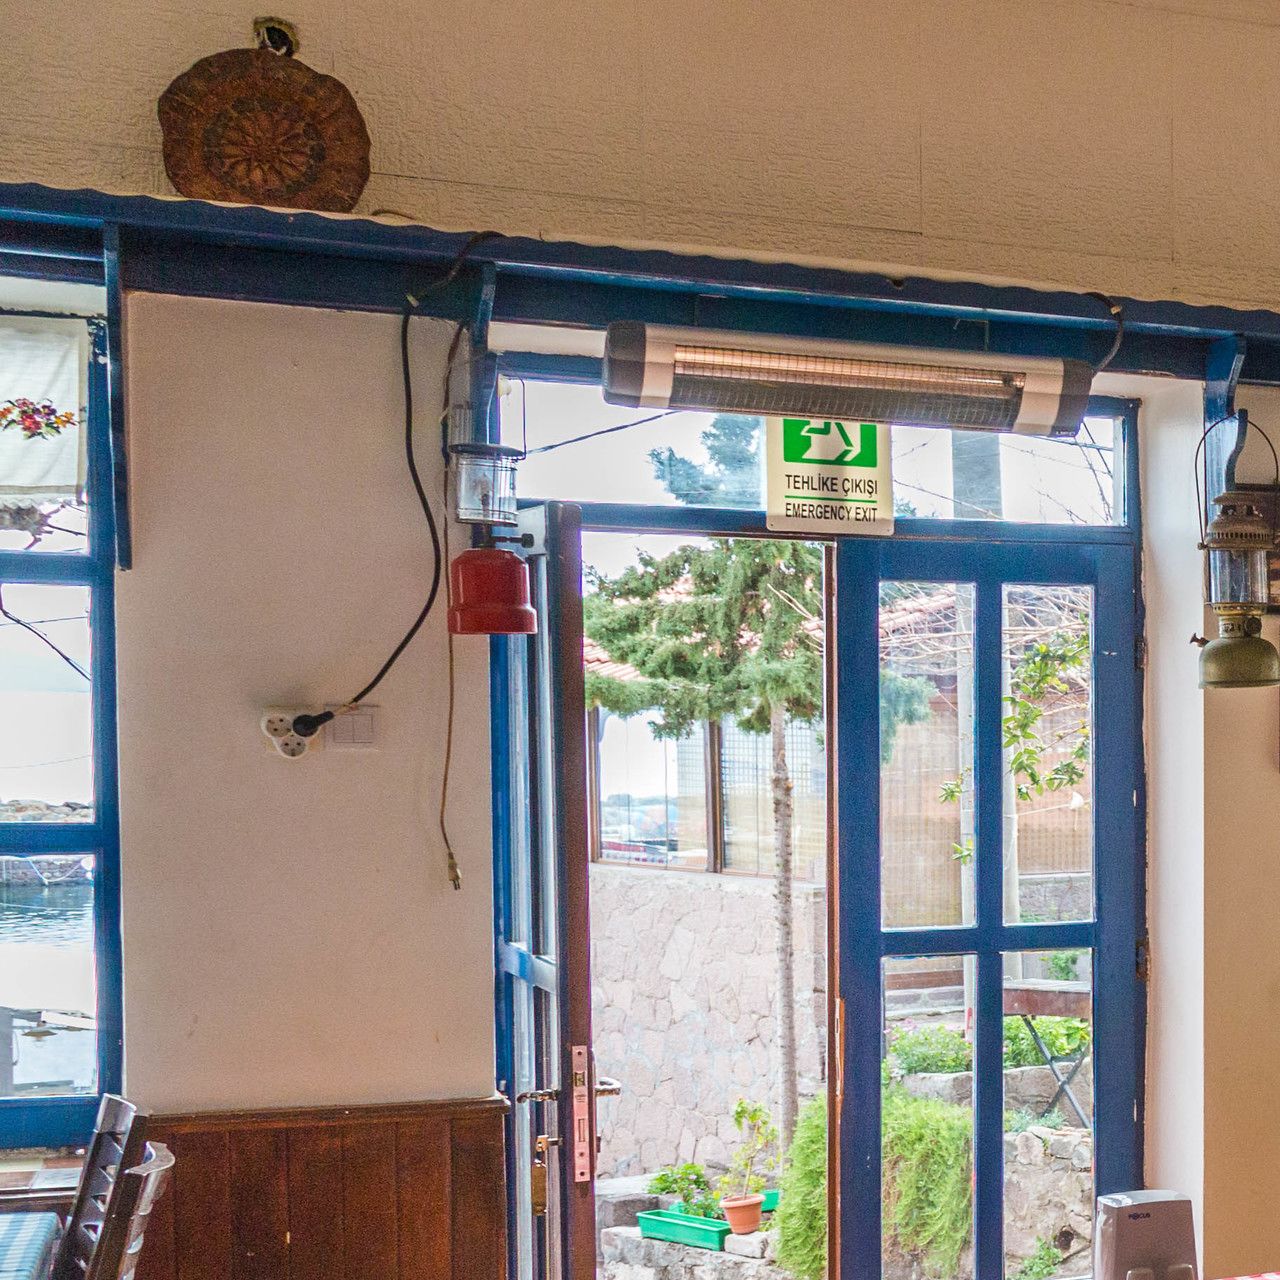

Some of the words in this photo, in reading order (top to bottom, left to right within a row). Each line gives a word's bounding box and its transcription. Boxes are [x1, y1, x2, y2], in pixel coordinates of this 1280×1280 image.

[785, 473, 838, 493] TEHLİKE
[842, 477, 878, 499] ÇIKIŞI
[785, 503, 853, 520] EMERGENCY
[855, 507, 878, 523] EXIT
